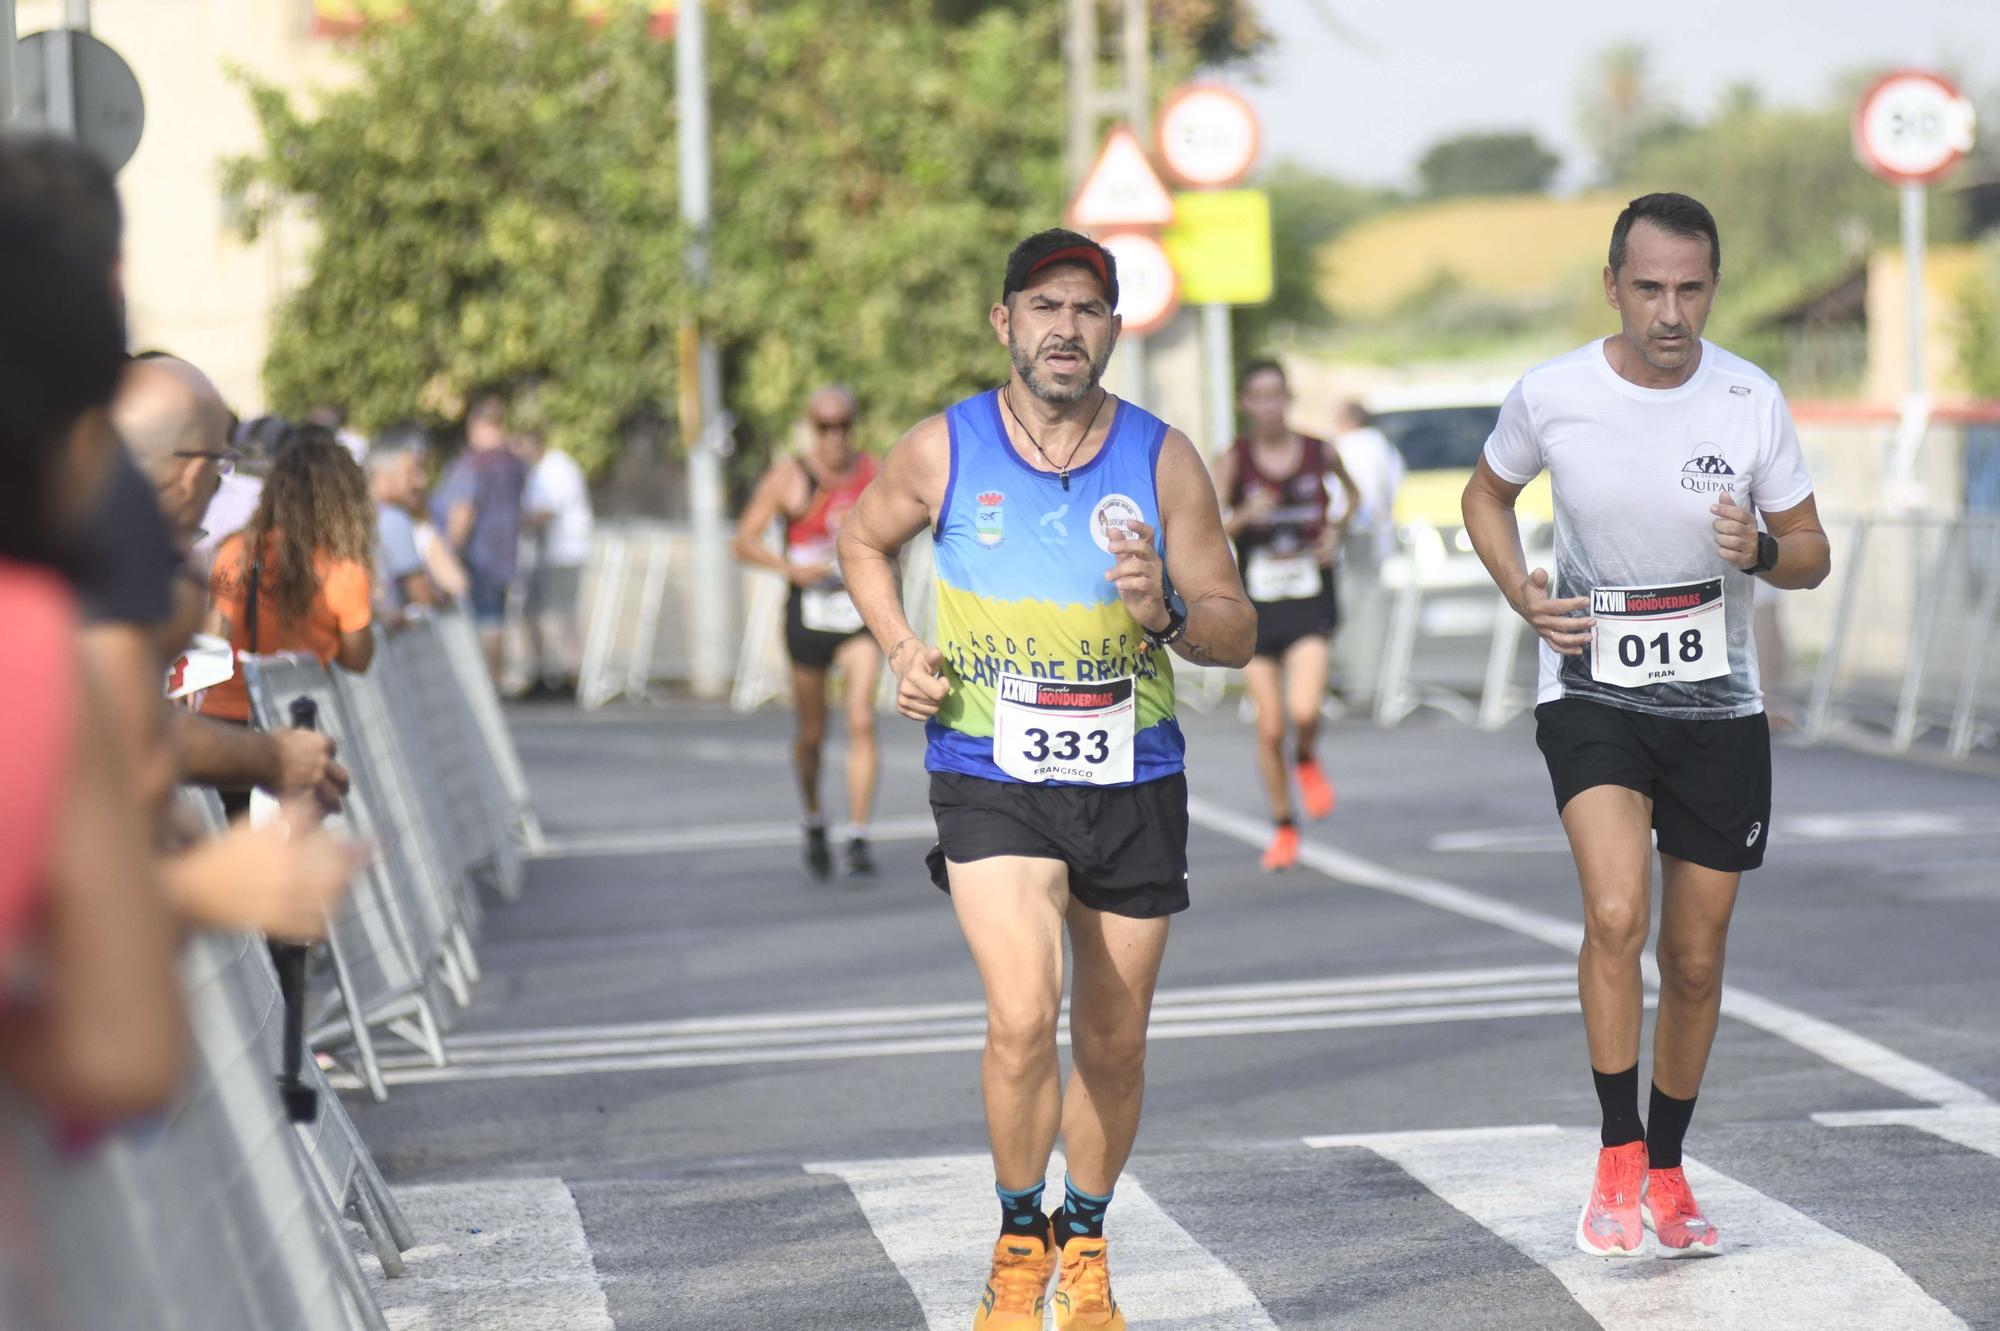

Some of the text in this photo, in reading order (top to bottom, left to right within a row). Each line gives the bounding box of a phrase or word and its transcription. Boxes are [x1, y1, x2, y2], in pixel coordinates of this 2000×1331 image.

[1595, 591, 1626, 612] XXVIII
[1627, 593, 1700, 612] NONDUERMAS
[1619, 629, 1703, 667] 018
[1648, 670, 1675, 679] FRAN
[1002, 677, 1037, 704] XXVIII
[1038, 691, 1113, 707] NONDUERMAS
[1023, 728, 1109, 764] 333
[1034, 766, 1093, 778] FRANCISCO
